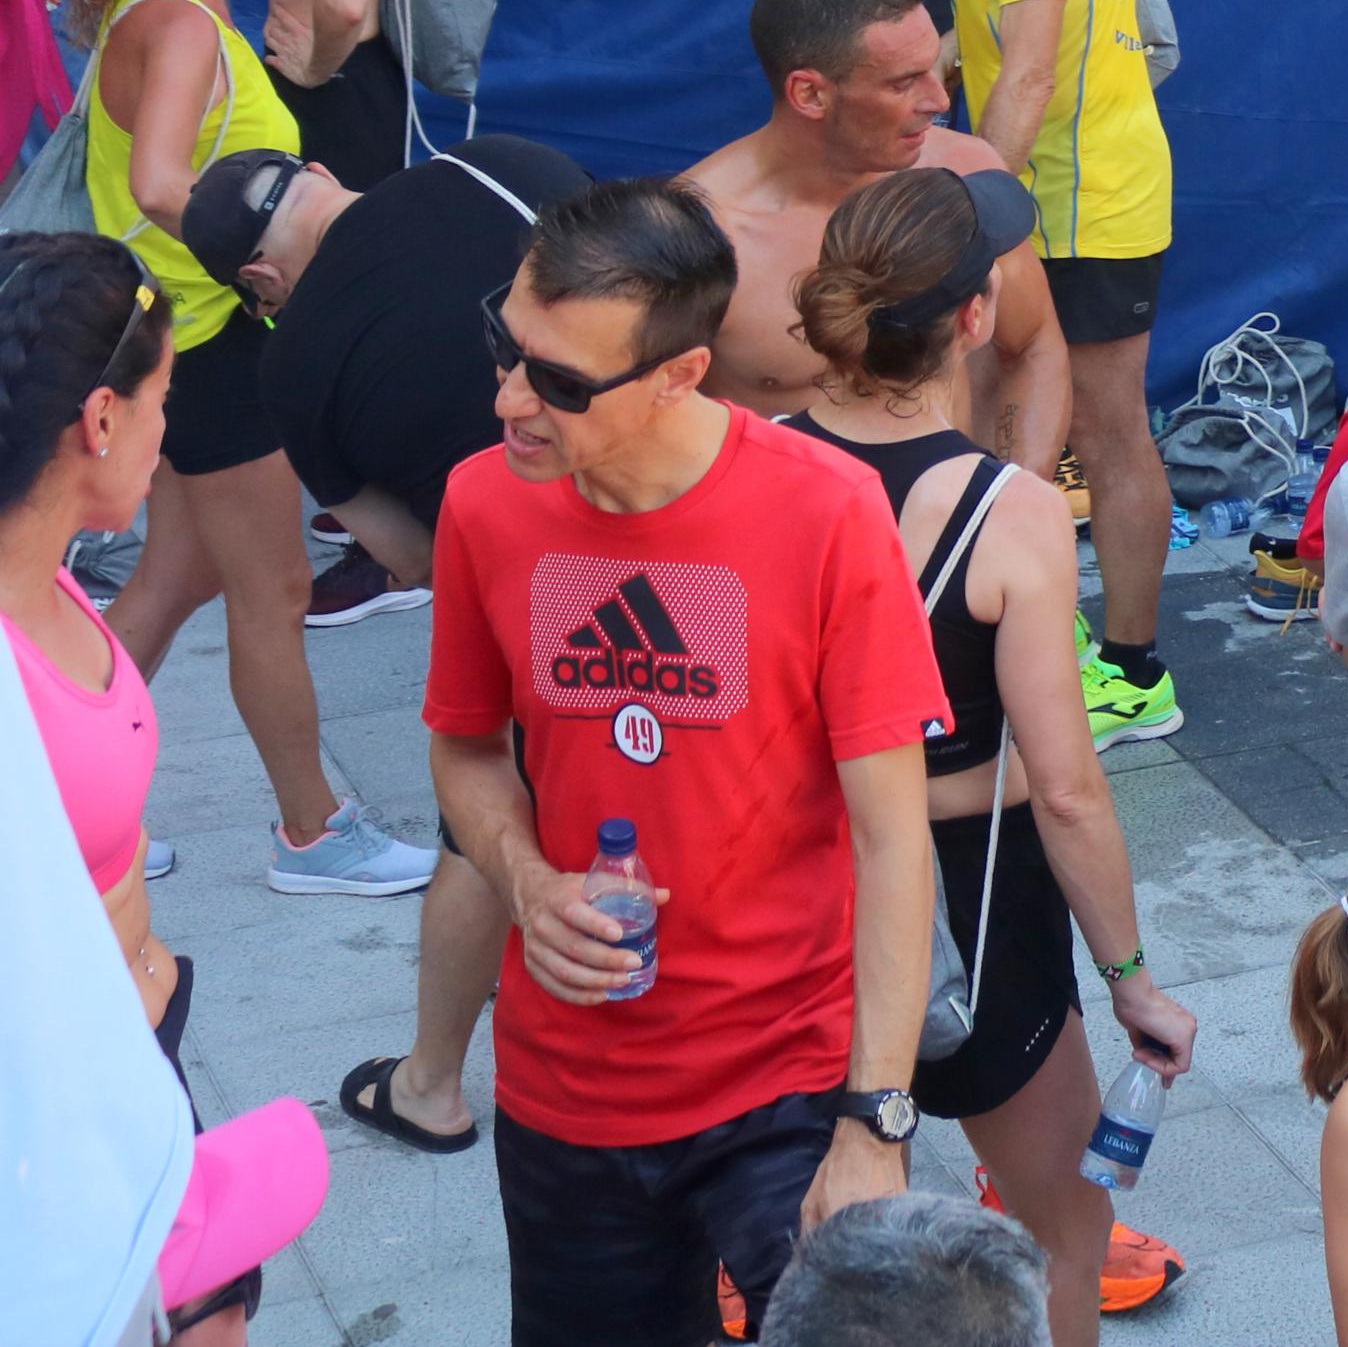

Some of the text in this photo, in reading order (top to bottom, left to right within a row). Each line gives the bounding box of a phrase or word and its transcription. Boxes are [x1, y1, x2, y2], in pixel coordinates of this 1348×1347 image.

[552, 649, 718, 699] adidas
[624, 715, 655, 754] 49
[1103, 1134, 1140, 1155] LEBANZA
